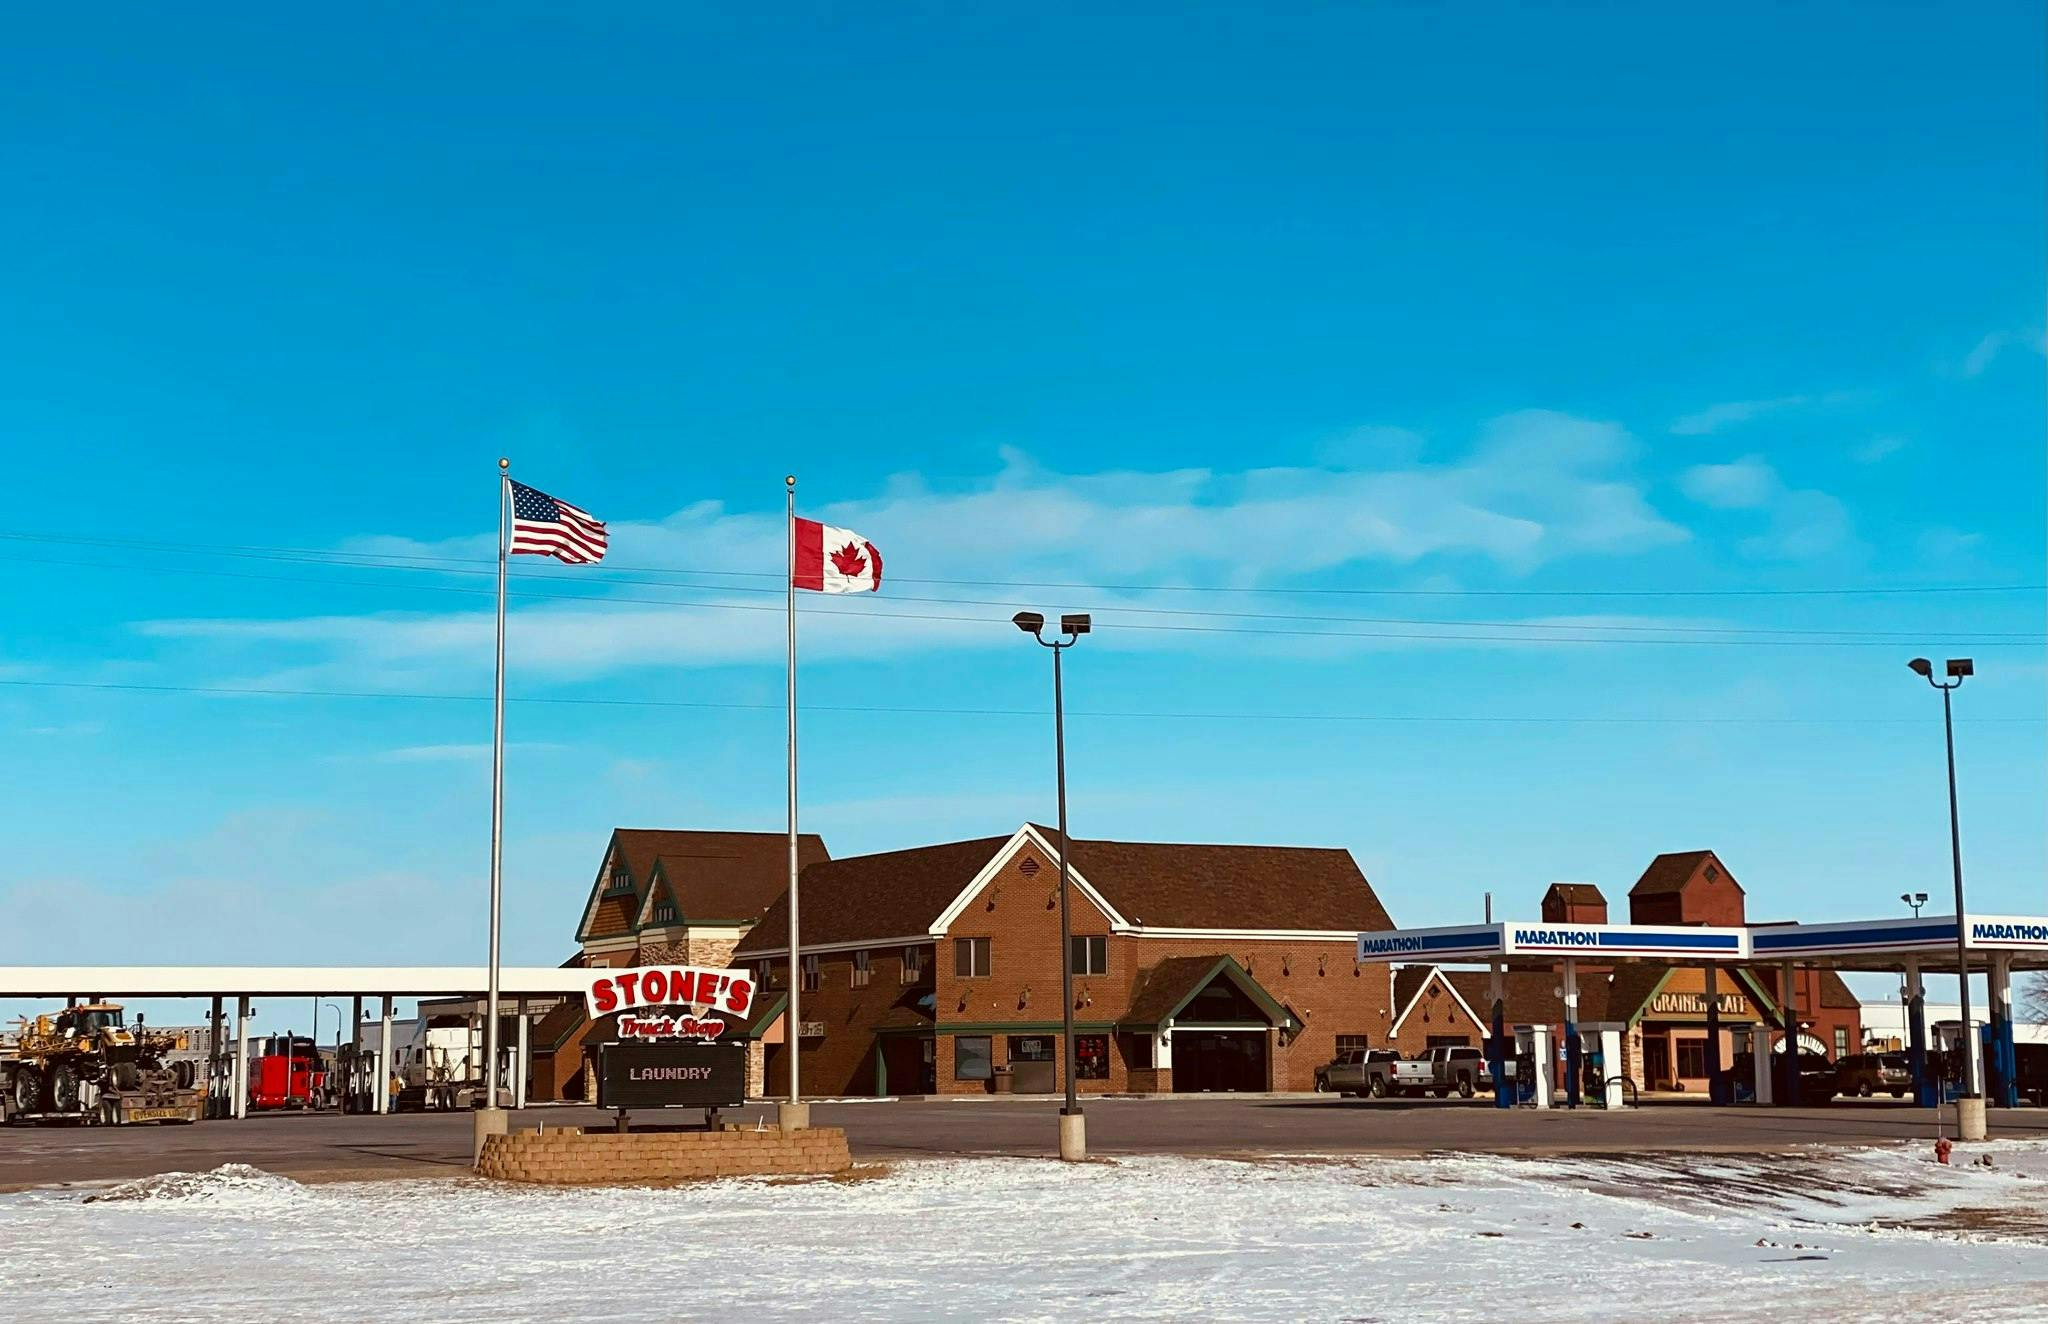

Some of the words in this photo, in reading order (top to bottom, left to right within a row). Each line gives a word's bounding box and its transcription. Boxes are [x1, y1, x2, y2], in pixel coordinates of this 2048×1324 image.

[1515, 930, 1597, 946] MARATHON
[1973, 924, 2048, 940] MARATHON
[1363, 937, 1422, 953] MARATHON
[592, 970, 751, 1013] STONE'S
[1653, 993, 1708, 1012] GRAINER
[620, 1017, 675, 1036] Truck
[679, 1017, 724, 1040] Stop
[630, 1067, 712, 1080] LAUNDRY
